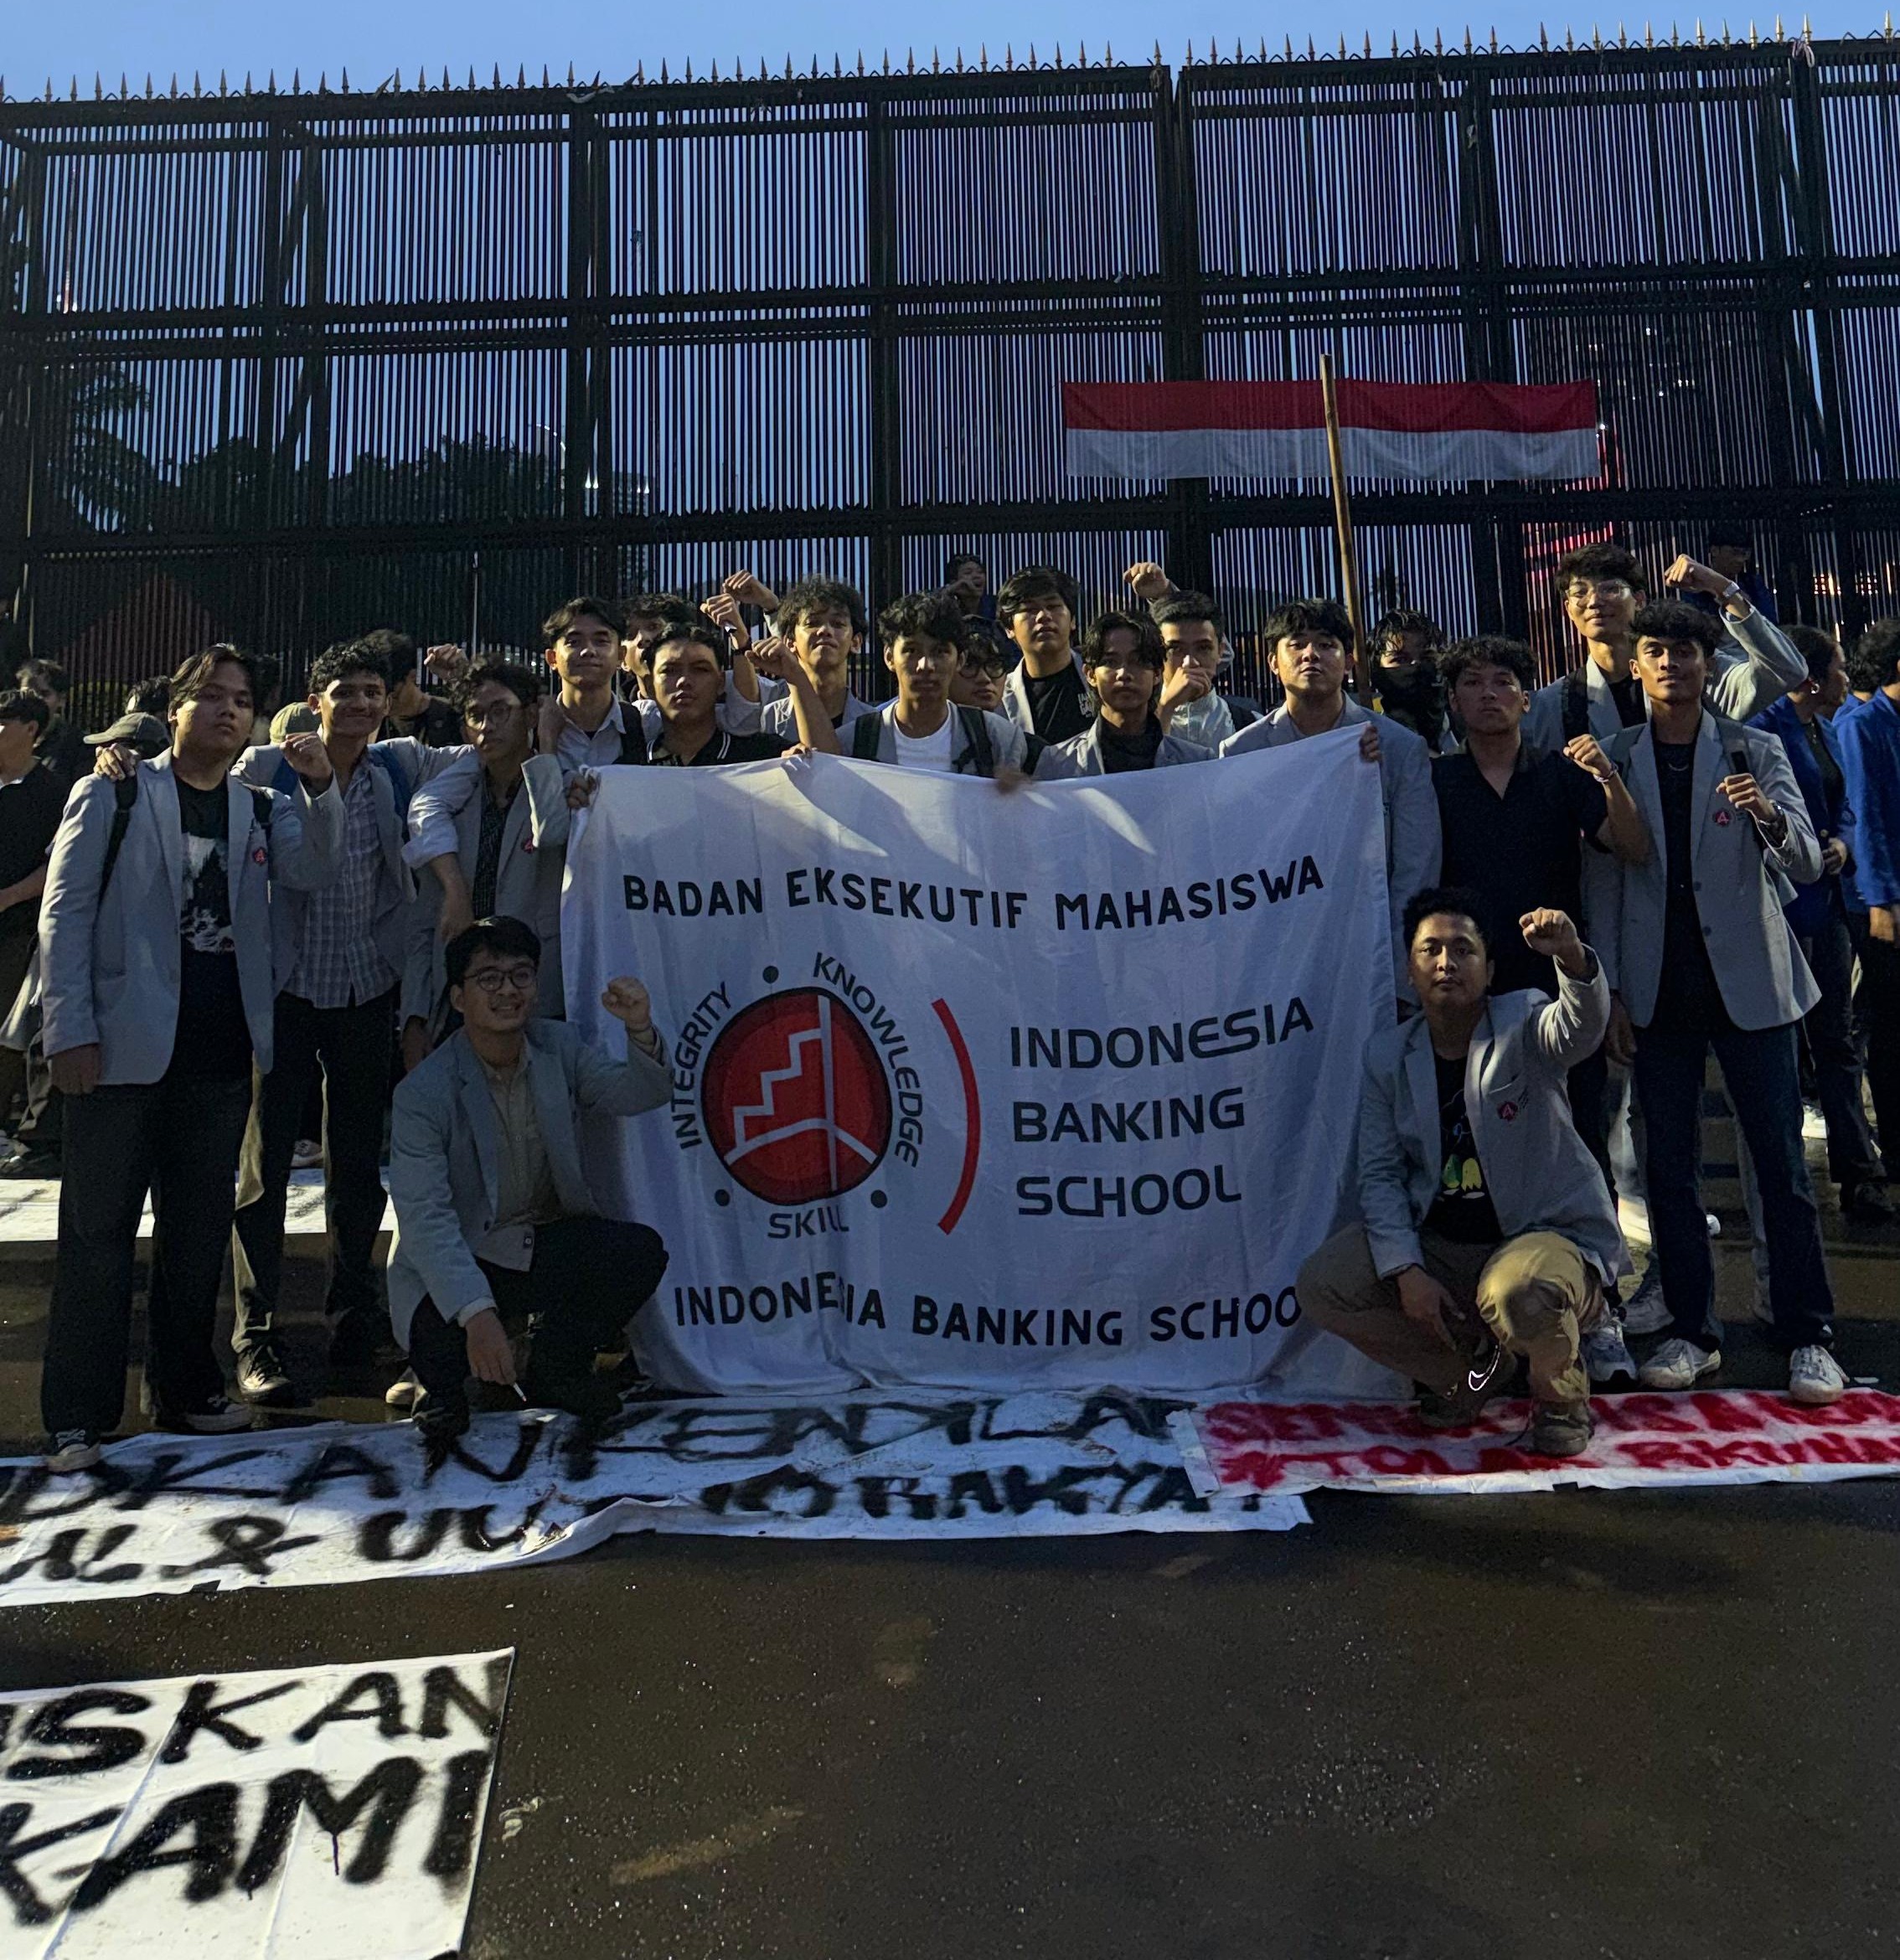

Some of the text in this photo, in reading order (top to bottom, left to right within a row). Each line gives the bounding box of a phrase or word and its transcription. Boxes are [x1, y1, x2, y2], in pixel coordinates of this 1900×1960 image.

[622, 854, 1324, 931] BADAN EKSEKUTIF MAHASISWA
[671, 980, 732, 1150] INTEGRITY
[812, 952, 924, 1168] KNOWLEDGE
[1010, 996, 1314, 1070] INDONESIA
[1013, 1086, 1246, 1143] BANKING
[1015, 1163, 1242, 1218] SCHOOL
[674, 1271, 1304, 1347] INDONEIA BANKING SCHOO
[1615, 1431, 1900, 1469] RKUHA
[0, 1750, 497, 1926] KAMI
